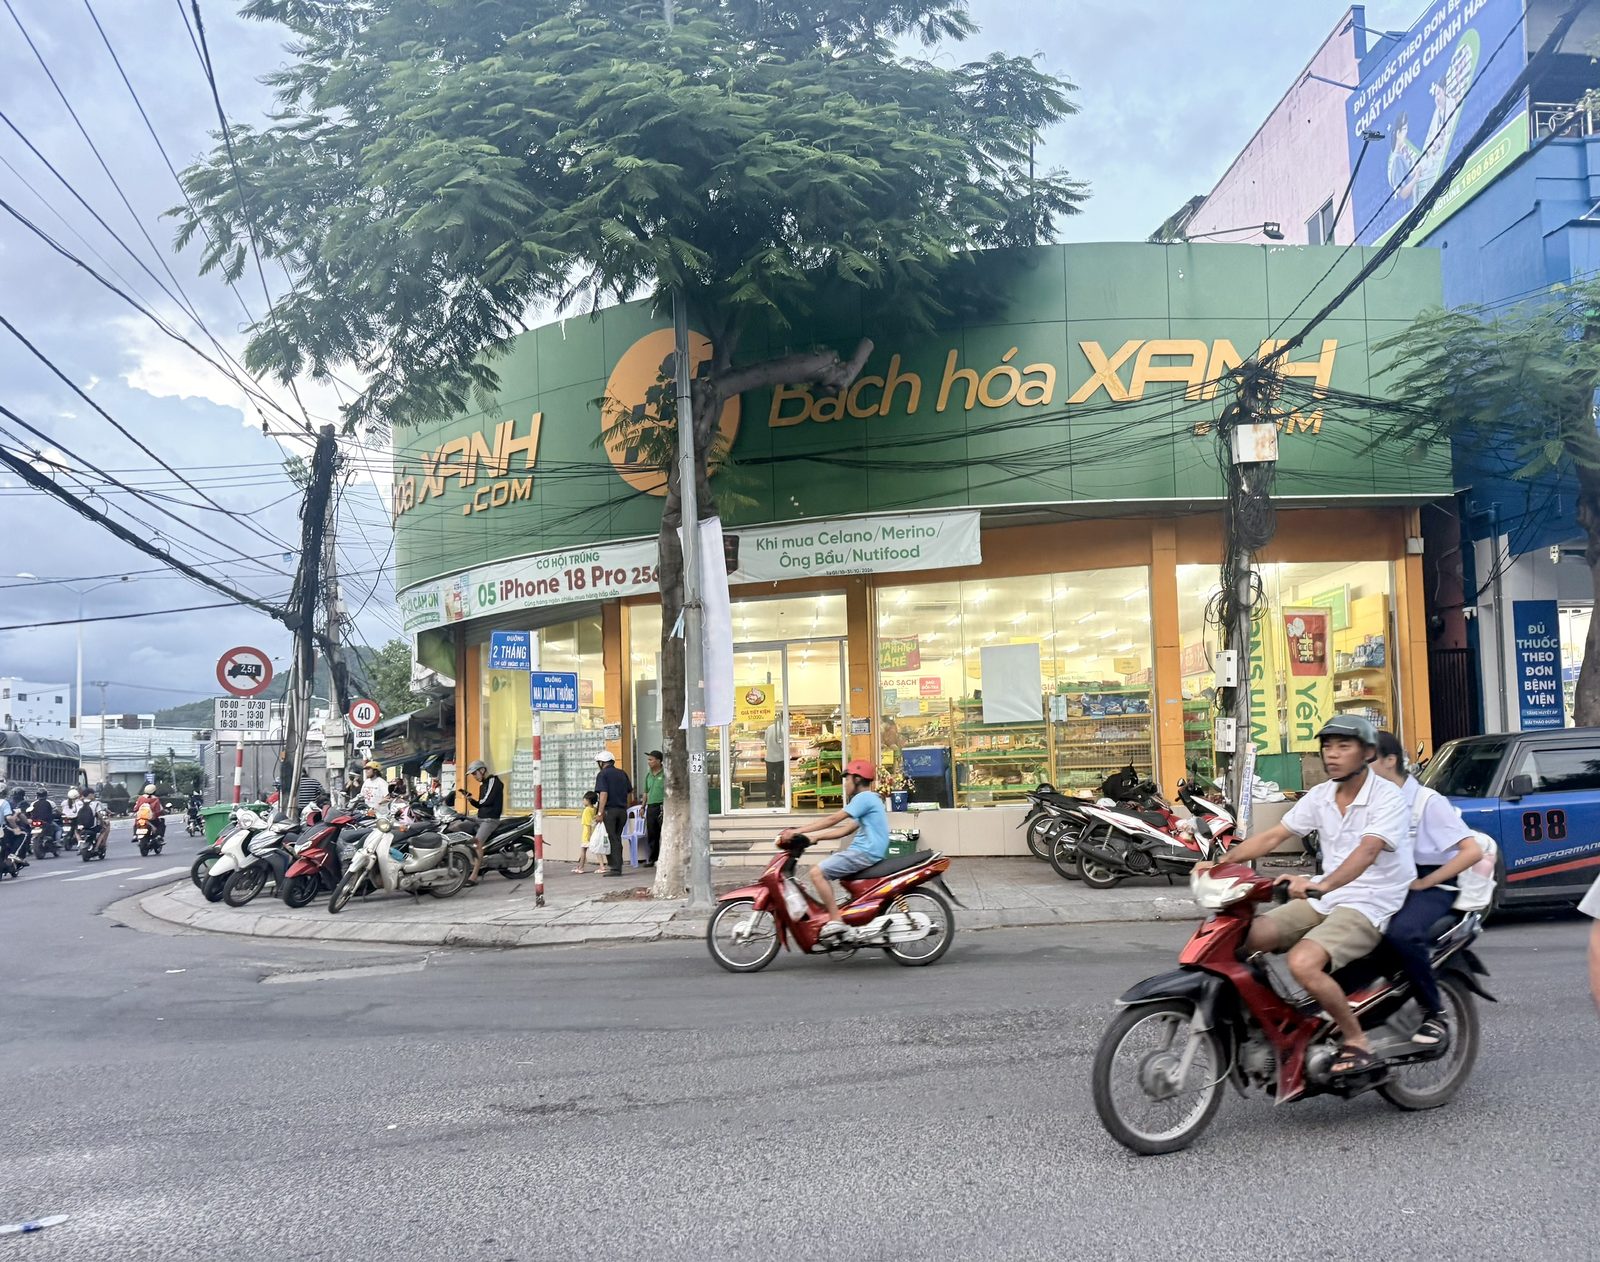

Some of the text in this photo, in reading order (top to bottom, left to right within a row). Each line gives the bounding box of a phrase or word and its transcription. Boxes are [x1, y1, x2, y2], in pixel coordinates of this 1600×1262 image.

[1353, 89, 1366, 115] ĐỦ
[1367, 61, 1398, 100] THUỐC
[1398, 33, 1422, 68] THEO
[1423, 7, 1446, 41] ĐƠN
[1355, 98, 1382, 137] CHẤT
[1383, 59, 1421, 110] LƯỢNG
[1422, 13, 1462, 67] CHÍNH
[936, 346, 1056, 413] hóa
[1066, 339, 1338, 404] XANH
[418, 412, 542, 504] XANH
[463, 474, 534, 516] .COM
[756, 537, 778, 551] Khi
[782, 535, 814, 549] mua
[536, 551, 601, 570] CƠ HỘI TRÚNG
[779, 552, 811, 569] Ông
[478, 582, 497, 607] 05
[500, 577, 560, 601] iPhone
[564, 568, 587, 591] 18
[591, 566, 627, 588] Pro
[1528, 621, 1545, 634] ĐỦ
[1517, 635, 1558, 649] THUỐC
[492, 643, 527, 659] 2 THÁNG
[1522, 652, 1554, 662] THEO
[240, 664, 256, 674] 2,5t
[1525, 665, 1553, 676] ĐƠN
[1524, 679, 1556, 693] BỆNH
[247, 701, 266, 710] 07:30
[1527, 693, 1555, 707] VIỆN
[221, 710, 238, 718] 11:30
[247, 711, 264, 719] 13:30
[357, 706, 371, 720] 40
[1295, 680, 1322, 742] Yến
[220, 720, 238, 728] 16:30
[247, 720, 264, 729] 19:00
[1522, 808, 1567, 844] 88
